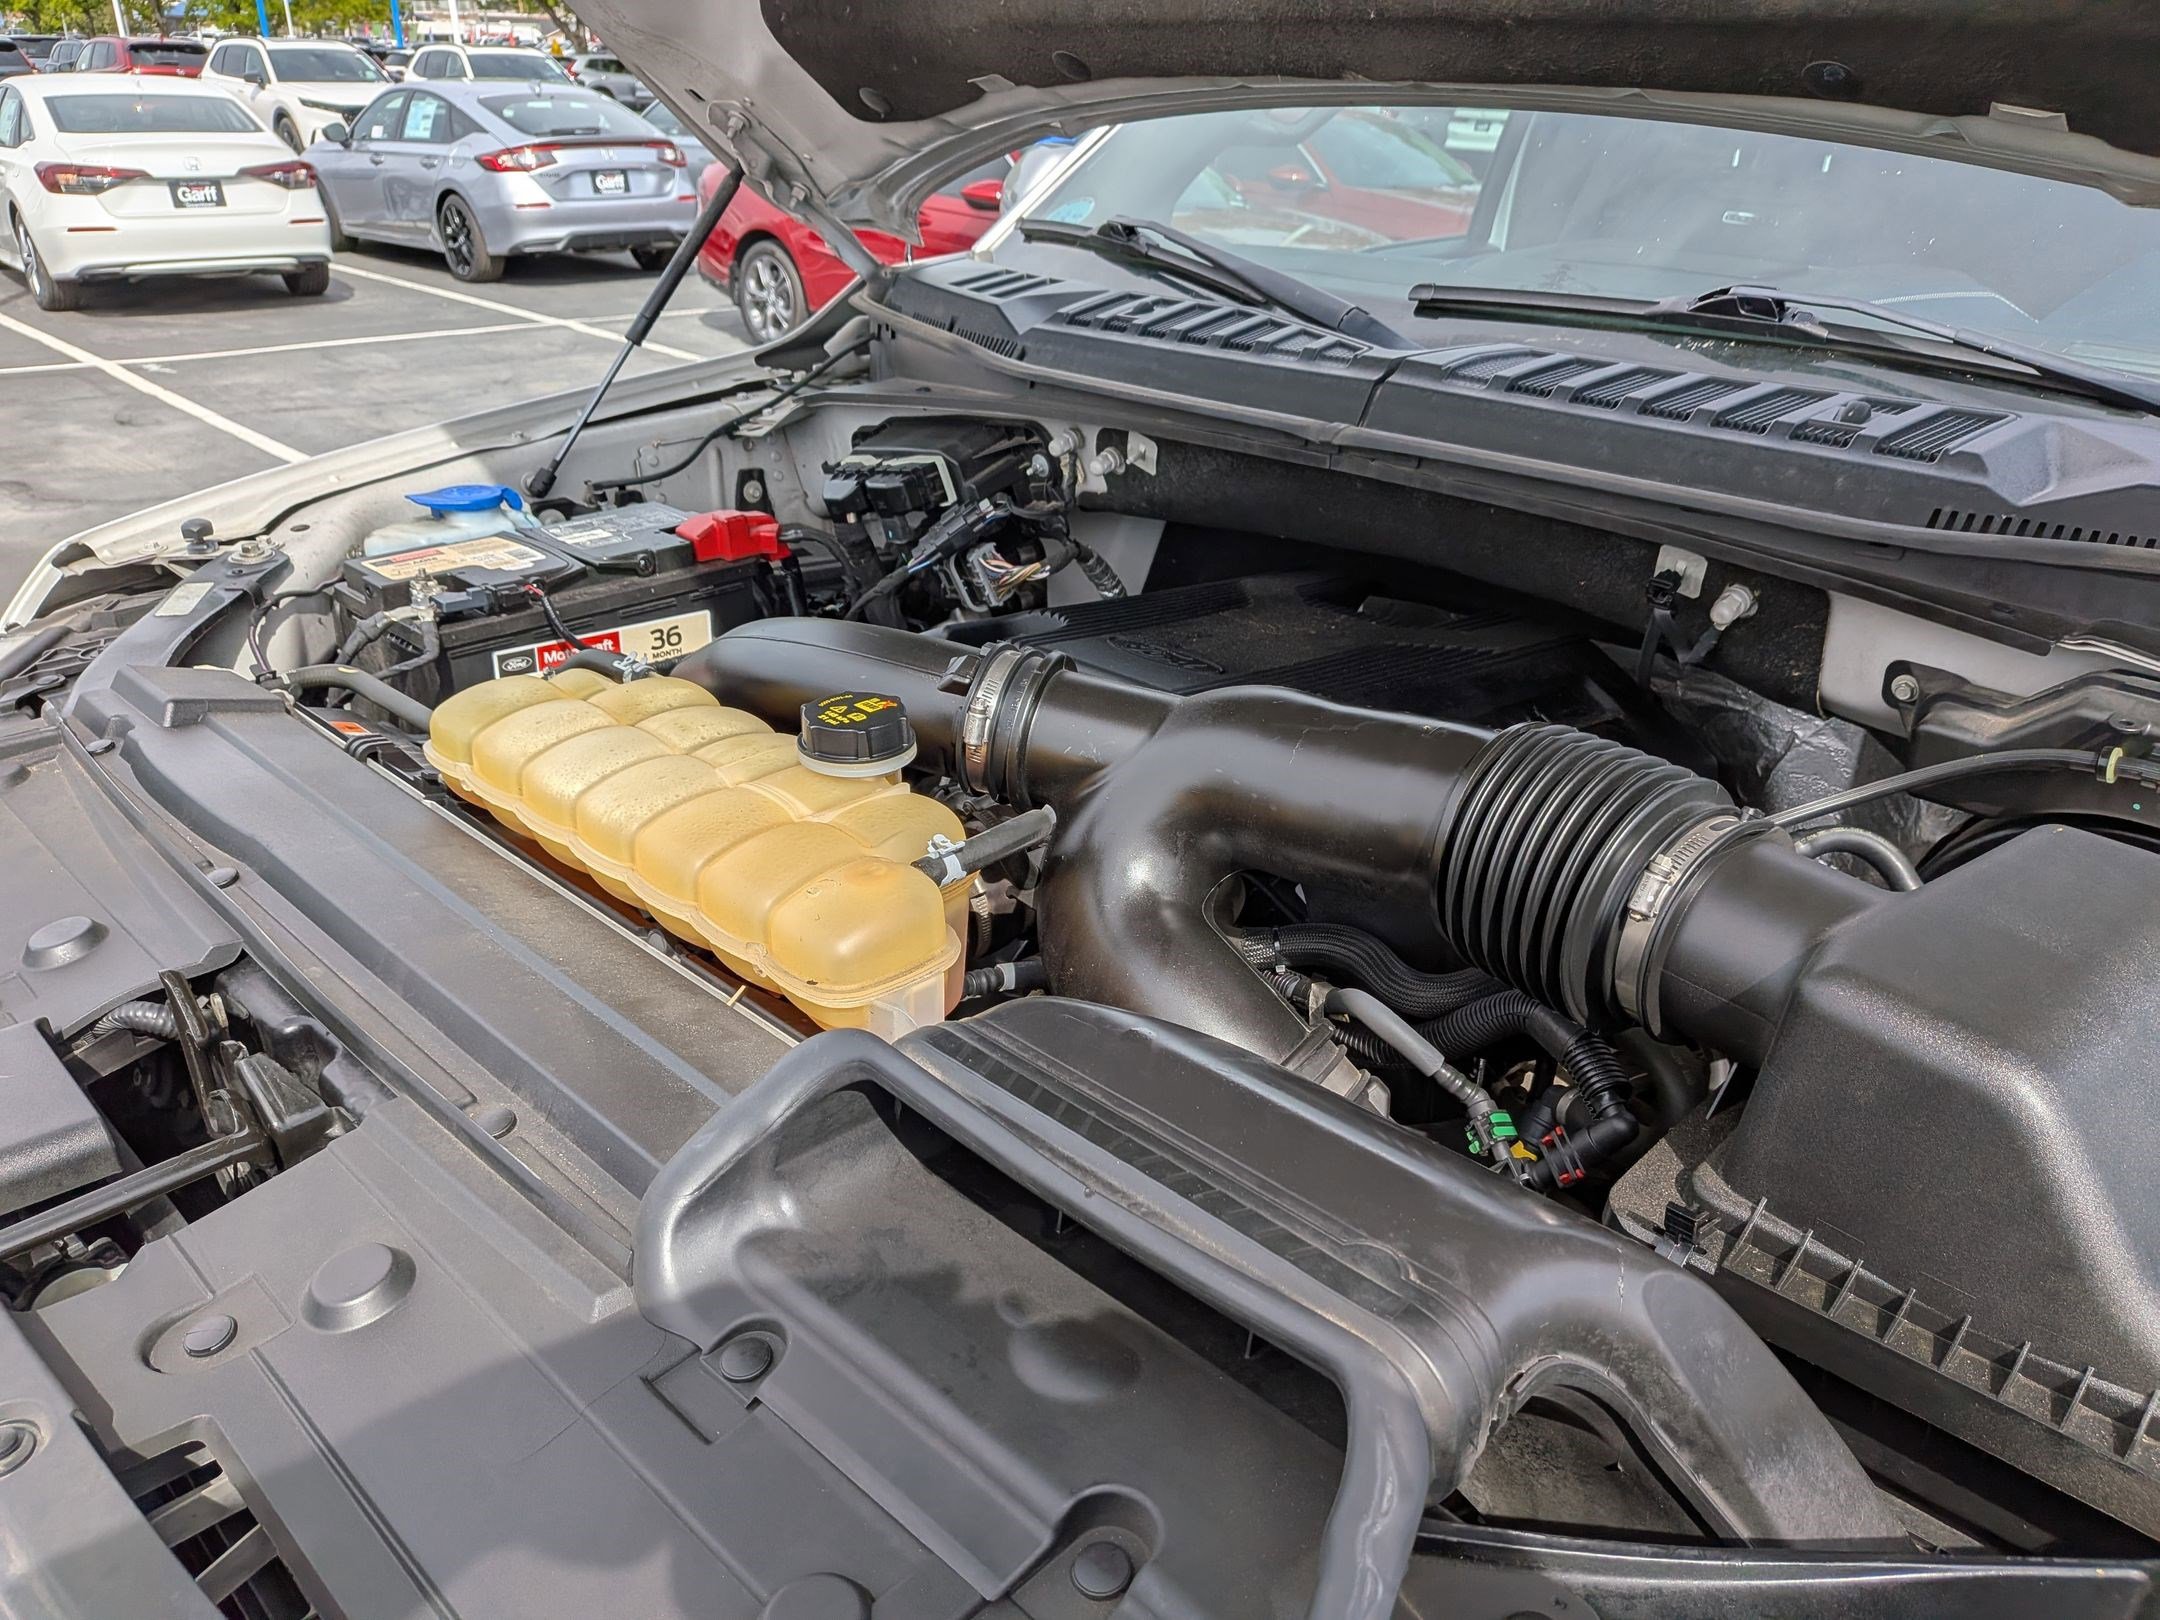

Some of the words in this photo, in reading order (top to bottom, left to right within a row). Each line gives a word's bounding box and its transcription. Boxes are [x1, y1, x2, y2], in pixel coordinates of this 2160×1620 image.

[177, 185, 218, 203] Garff
[650, 625, 683, 650] 36
[652, 648, 683, 660] MONTH
